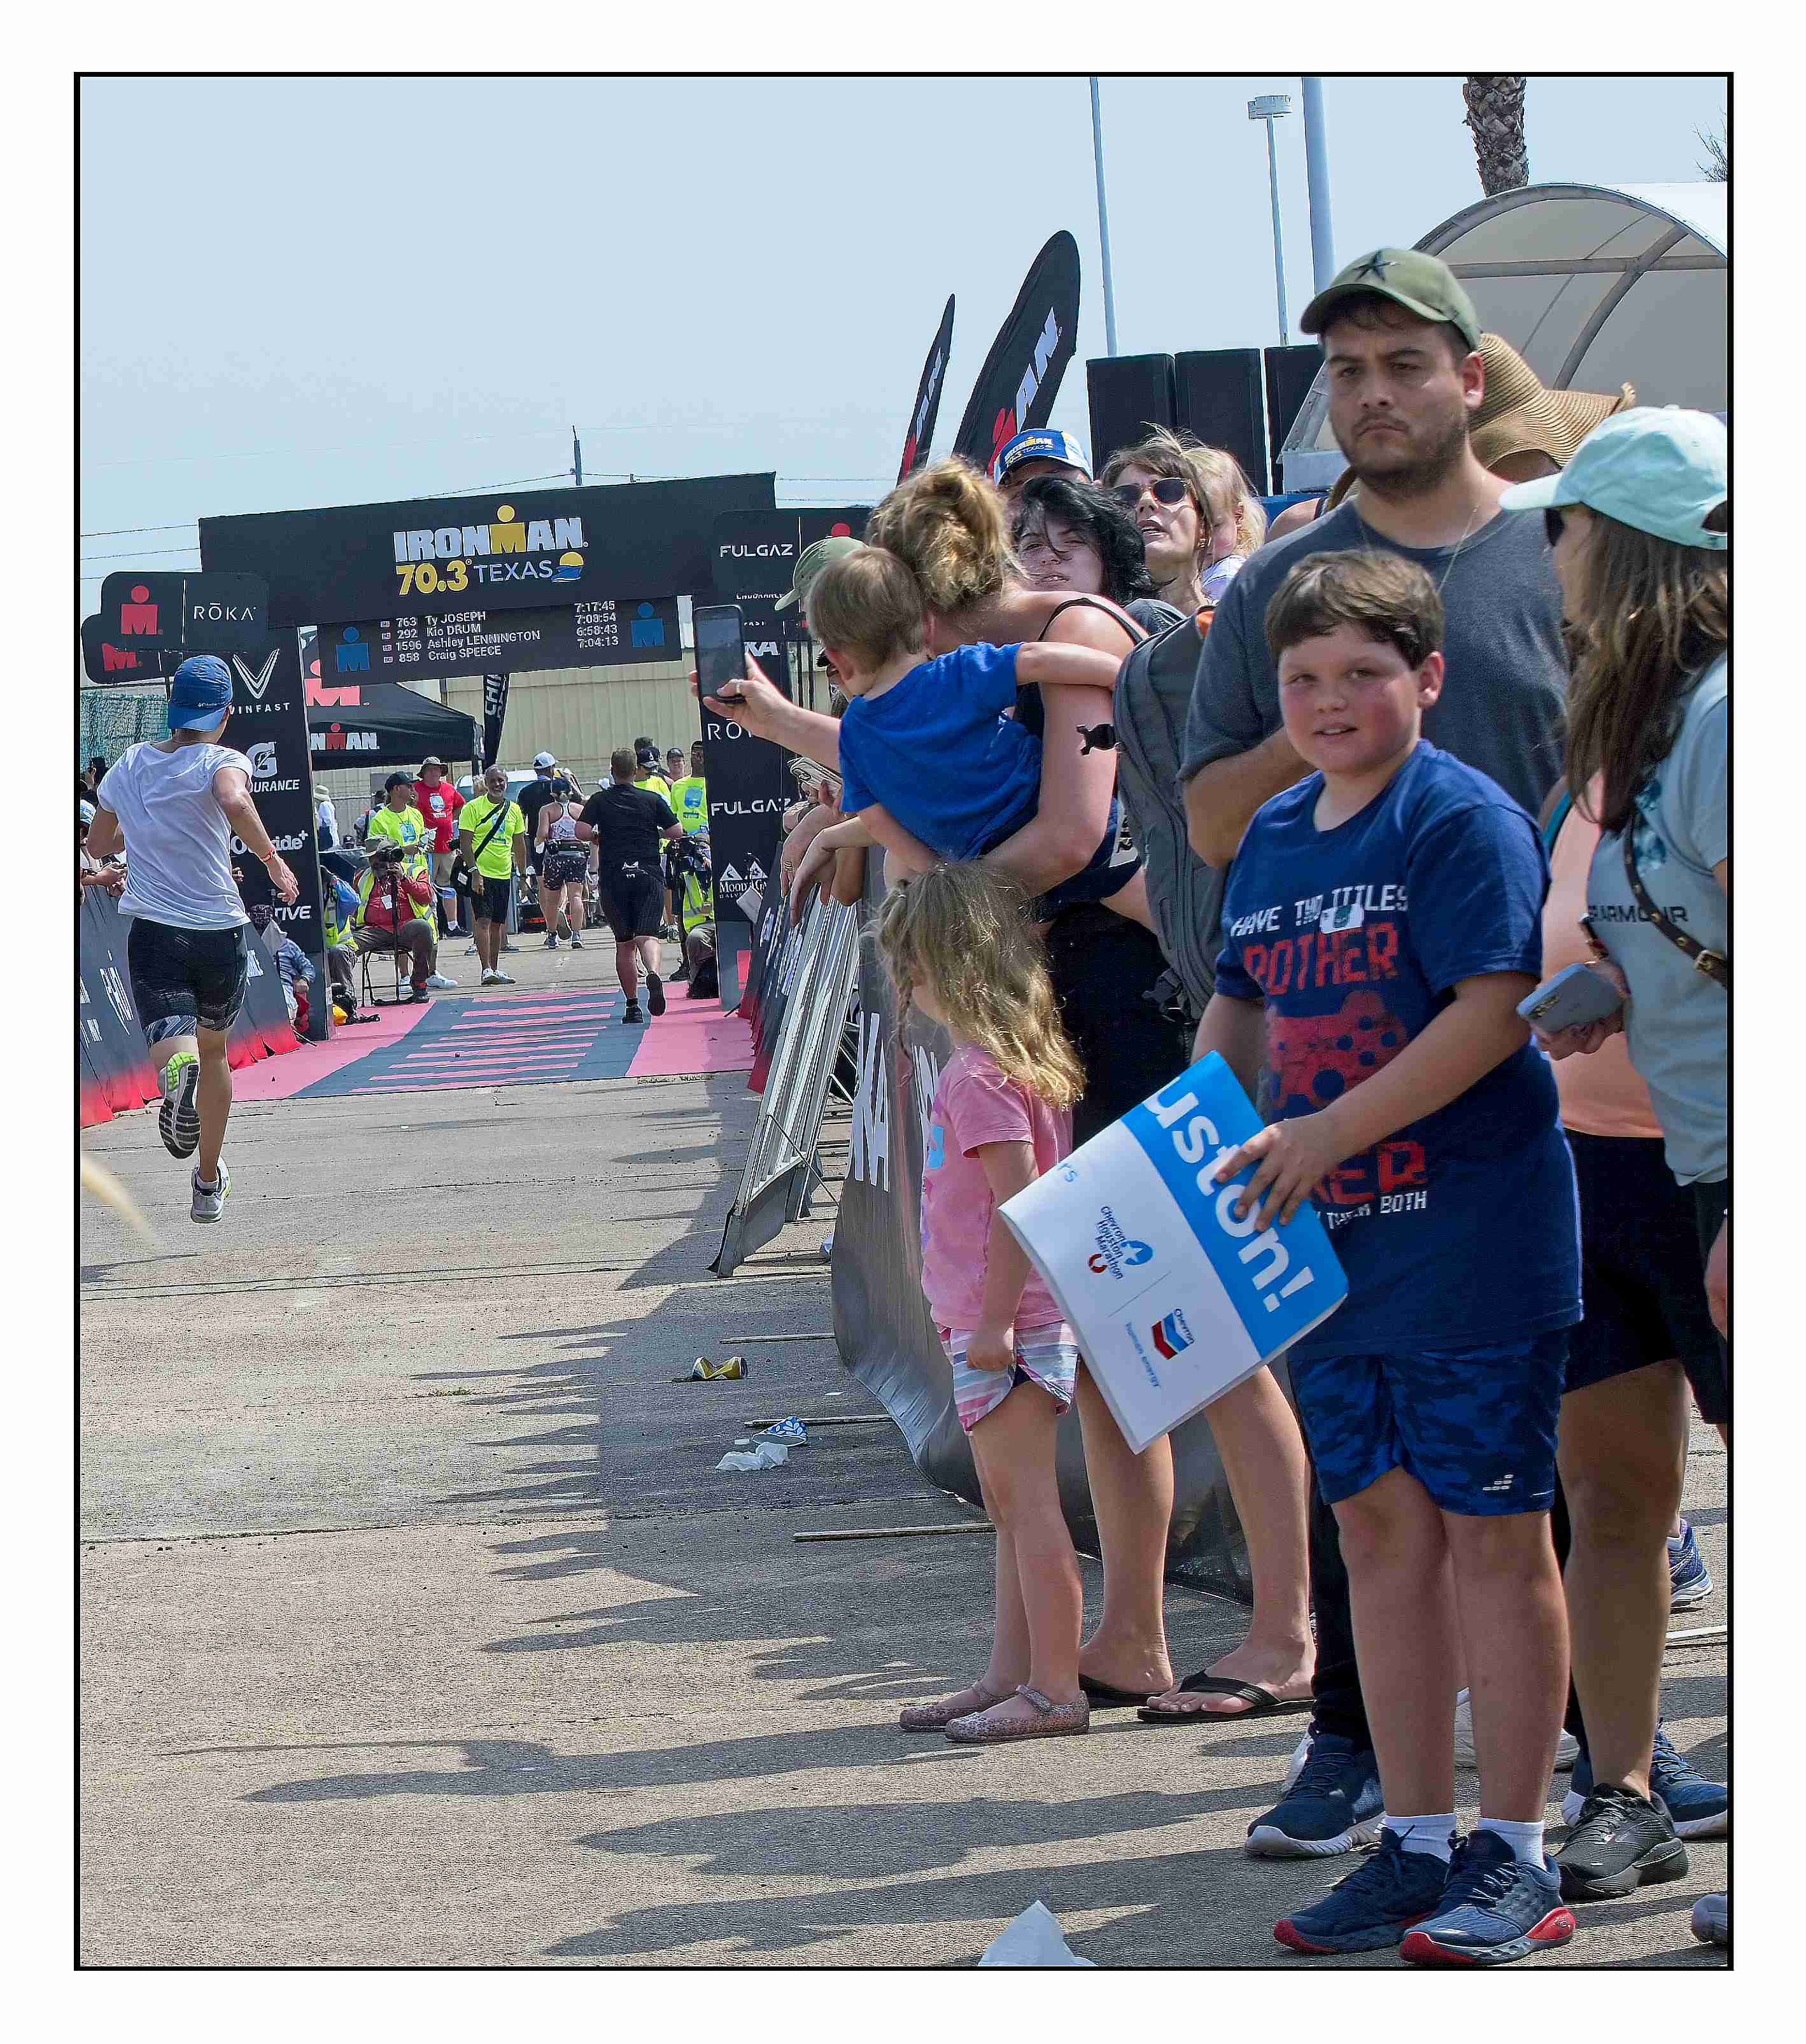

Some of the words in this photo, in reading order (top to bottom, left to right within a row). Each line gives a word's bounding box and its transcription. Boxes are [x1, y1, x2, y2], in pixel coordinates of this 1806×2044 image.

[393, 505, 583, 562] IRONMAN
[720, 544, 793, 558] FULGAZ
[396, 560, 469, 596] 70.3
[473, 560, 553, 584] TEXAS
[396, 617, 418, 628] 763
[425, 616, 438, 626] Ty
[441, 610, 486, 624] JOSEPH
[574, 601, 615, 613] 7:17:45
[396, 640, 422, 651] 1596
[427, 637, 464, 650] Ashley
[467, 630, 540, 646] LENNINGTON
[397, 629, 418, 639] 292
[447, 623, 481, 635] DRUM
[428, 649, 456, 661] Craig
[459, 645, 502, 658] SPEECE
[1379, 1191, 1427, 1214] BOTH
[1100, 1206, 1126, 1244] Chevron
[1096, 1220, 1124, 1258] Houston
[1095, 1234, 1124, 1281] Marathon
